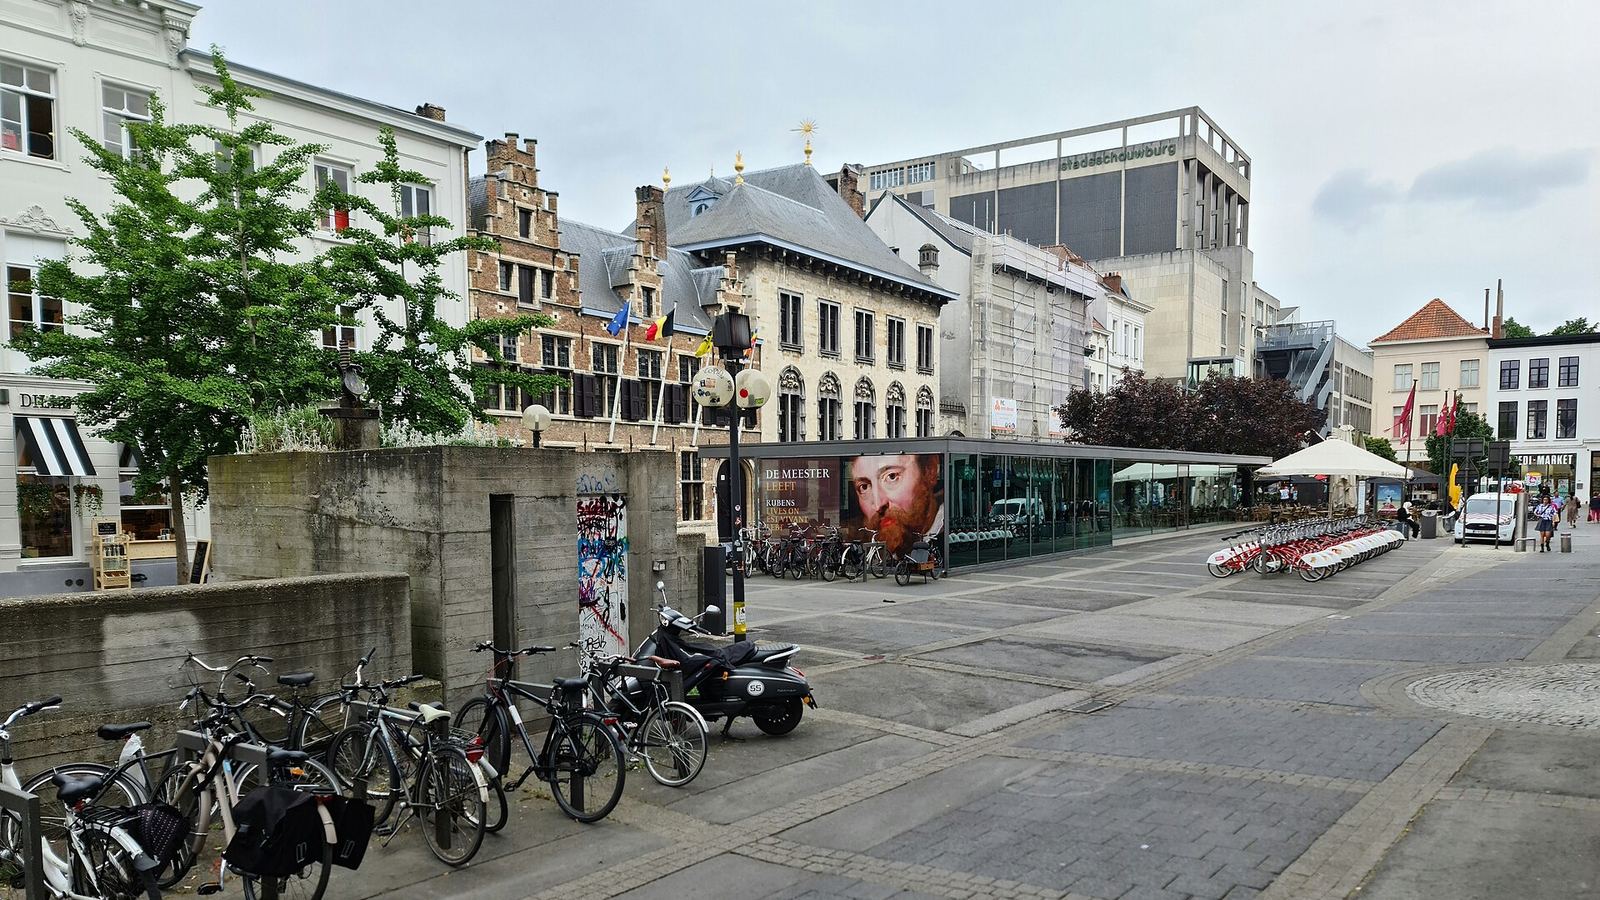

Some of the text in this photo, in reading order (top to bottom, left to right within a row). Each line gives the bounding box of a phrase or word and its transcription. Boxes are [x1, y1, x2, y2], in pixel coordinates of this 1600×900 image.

[20, 393, 71, 409] DIL
[766, 468, 830, 479] DE MEESTER
[766, 481, 797, 491] LEEFT
[766, 499, 796, 507] RUBENS
